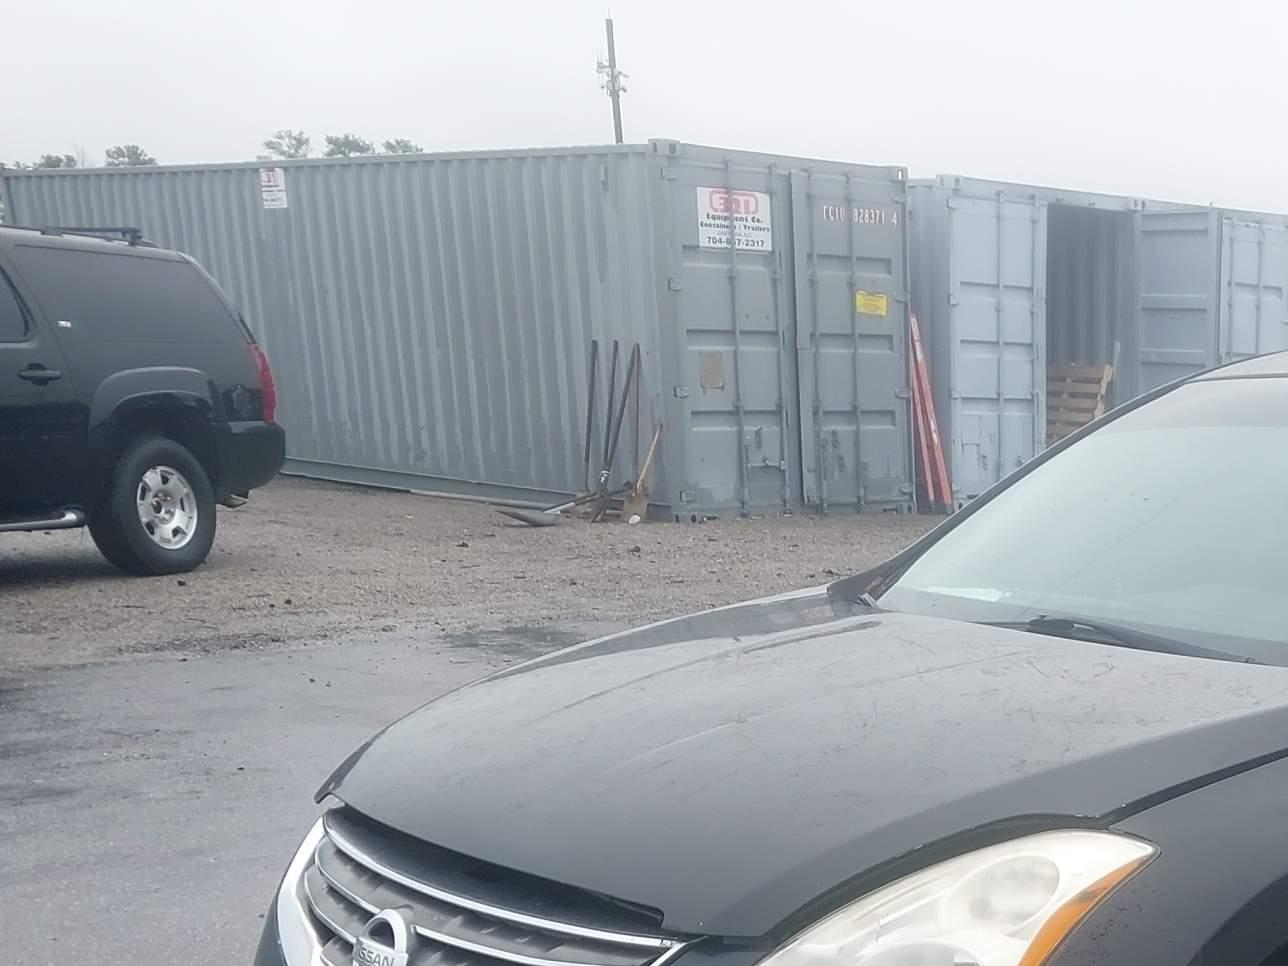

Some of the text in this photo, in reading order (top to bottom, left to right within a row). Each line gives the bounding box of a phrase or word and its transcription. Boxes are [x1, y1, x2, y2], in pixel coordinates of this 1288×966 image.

[706, 212, 748, 223] Equipent
[853, 208, 885, 224] 828371
[891, 211, 898, 227] 4
[700, 221, 737, 230] Containes
[743, 224, 770, 233] Trailers
[706, 236, 765, 247] 704-87-2317
